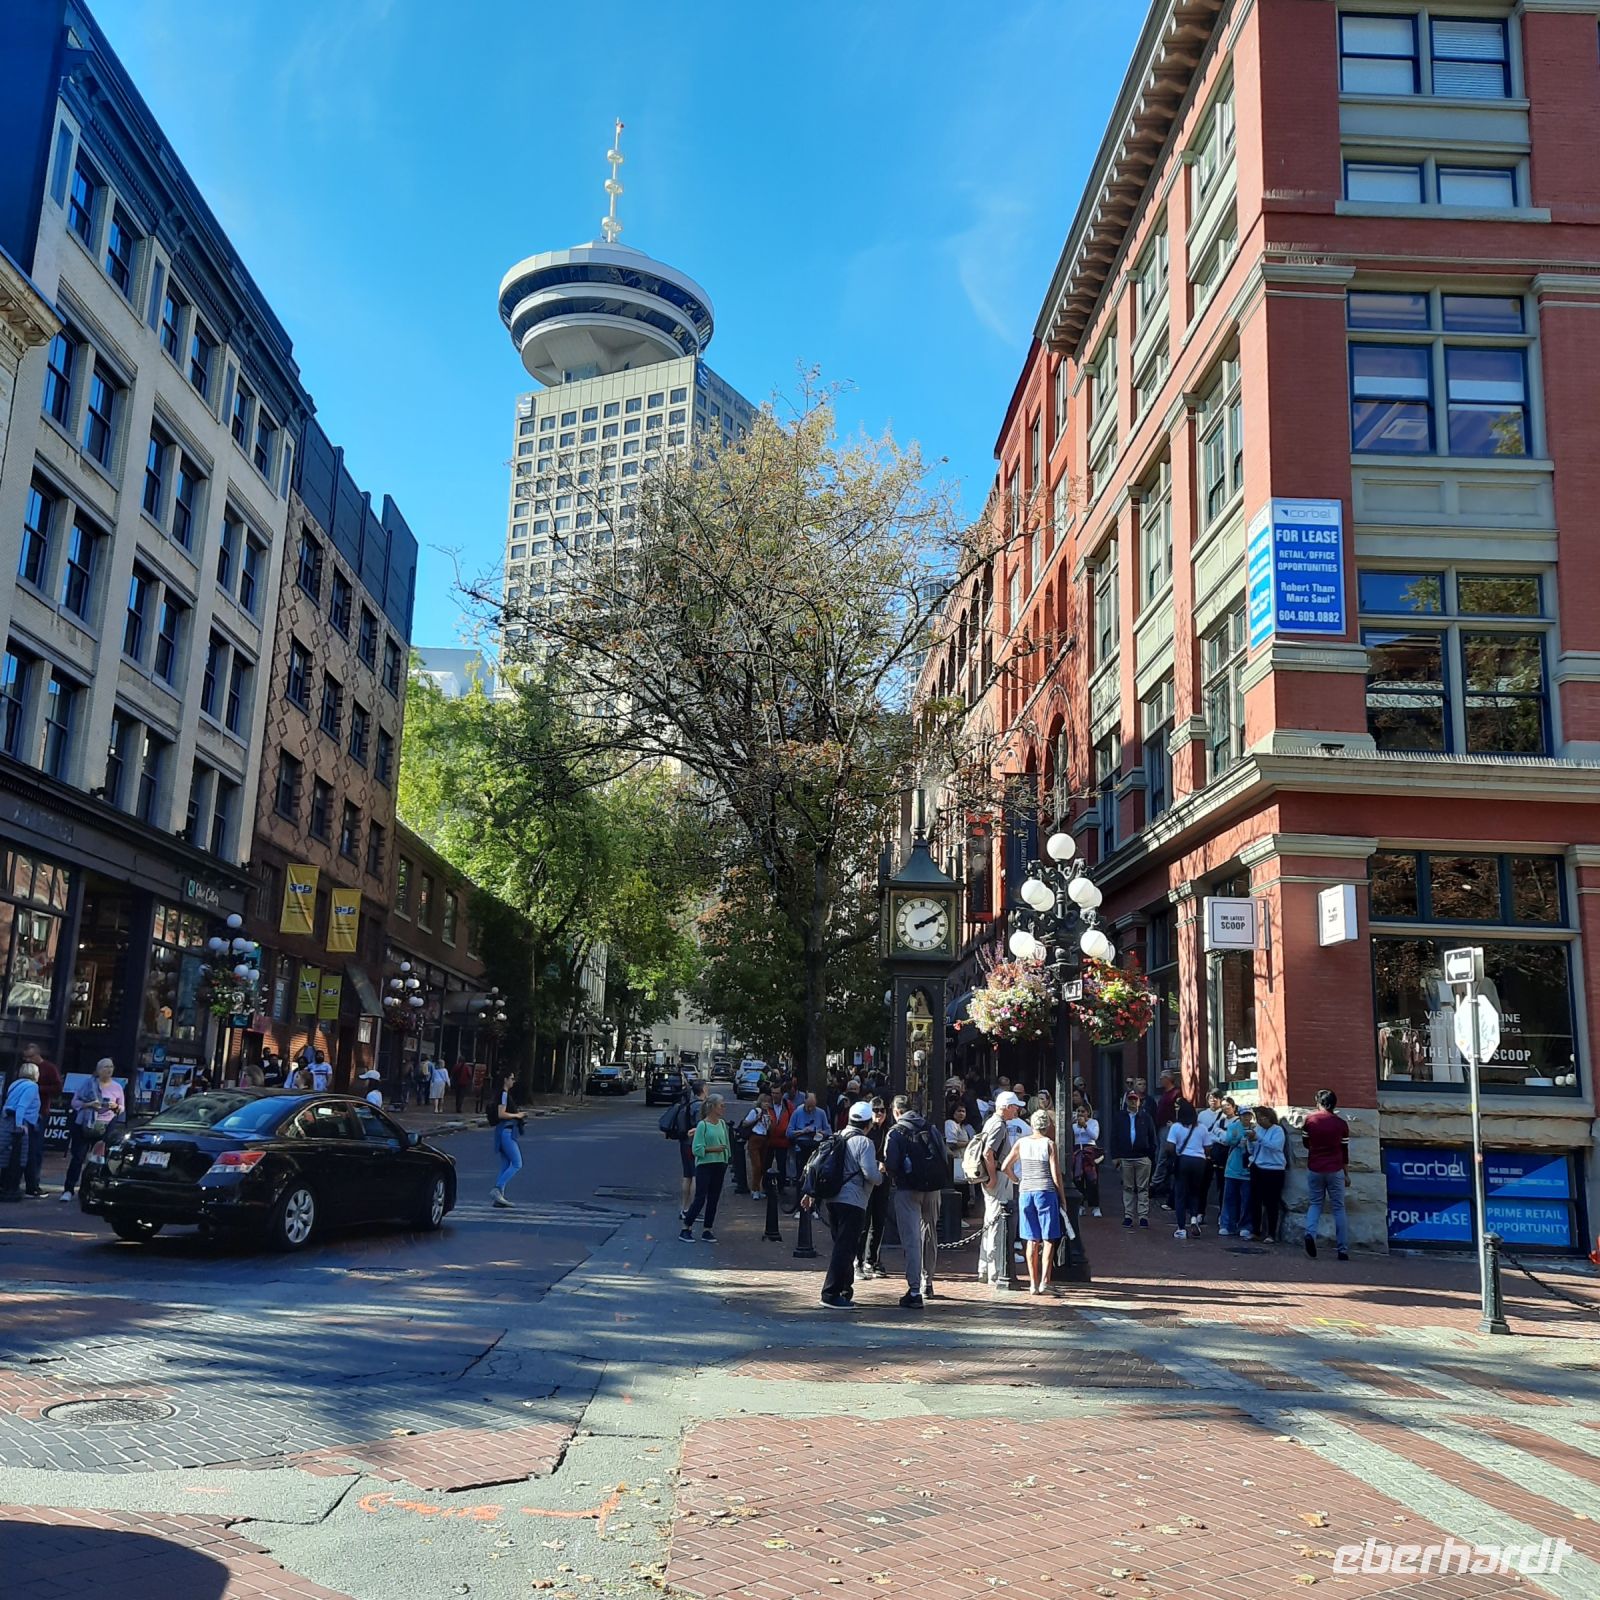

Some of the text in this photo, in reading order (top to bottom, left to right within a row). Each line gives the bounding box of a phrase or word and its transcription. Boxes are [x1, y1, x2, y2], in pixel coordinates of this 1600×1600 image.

[1290, 509, 1331, 518] corbel
[1275, 529, 1338, 544] FOR LEASE
[1279, 550, 1336, 560] RETAIL/OFFICE
[1277, 562, 1338, 573] OPPORTUNITIES
[1280, 581, 1336, 593] Robert Tham
[1286, 593, 1309, 603] Marc
[1278, 610, 1340, 623] 604.609.0882
[1220, 921, 1246, 930] SCOOP
[1422, 1046, 1443, 1058] THE
[1493, 1049, 1532, 1061] SCOOP
[48, 1115, 68, 1126] IVE
[43, 1128, 70, 1139] USIC
[1402, 1160, 1466, 1177] corbel
[1390, 1210, 1469, 1226] FOR LEASE
[1486, 1207, 1563, 1220] PRIME RETAIL
[1487, 1222, 1569, 1234] OPPORTUNITY
